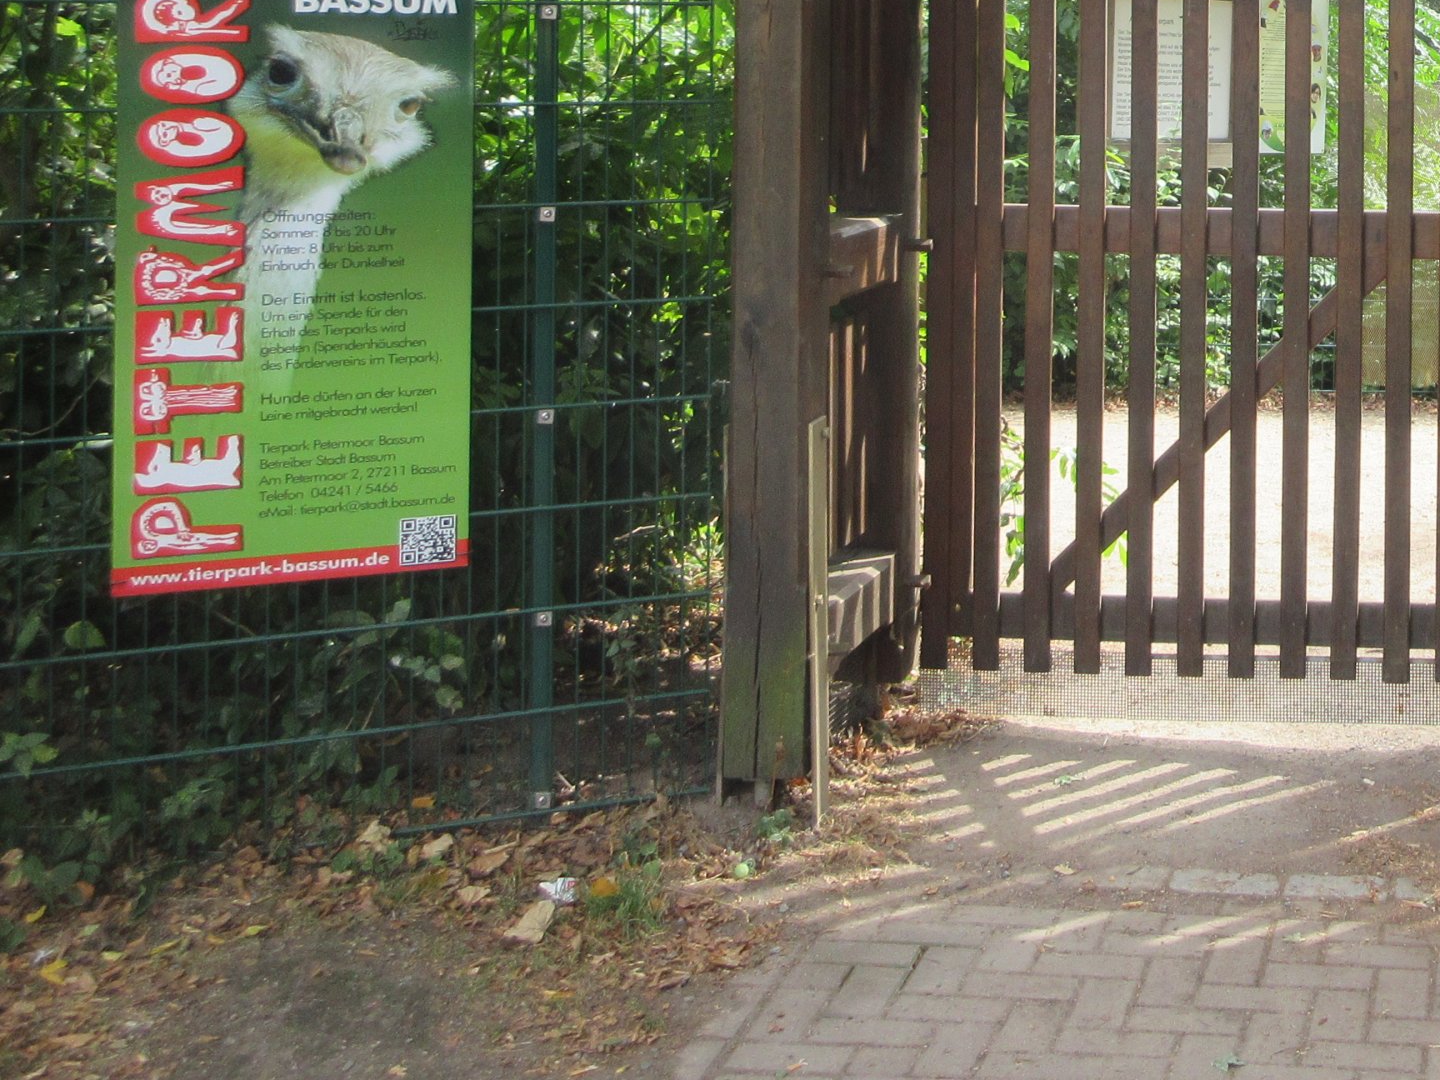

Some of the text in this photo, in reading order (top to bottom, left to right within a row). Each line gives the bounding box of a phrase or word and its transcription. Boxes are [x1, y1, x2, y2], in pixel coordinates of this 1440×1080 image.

[262, 209, 376, 224] Öffnungszeiten:
[261, 224, 398, 240] Sommer: 8 bis 20 Uhr
[261, 242, 393, 255] Winter: 8 Uhr bis zum
[261, 257, 405, 272] Einbruch der Dunkelheit
[261, 288, 427, 306] Der Eintritt ist kostenlos.
[261, 305, 408, 323] Um eine Spende für den
[261, 322, 406, 339] Erhalt des Tierparks wird
[259, 337, 427, 357] gebeten (Spendenhäuschen
[260, 350, 443, 371] des Fördervereins im Tierpark).
[260, 386, 437, 405] Hunde dürfen an der kurzen
[260, 402, 418, 422] Leine mitgebracht werden!
[260, 434, 425, 455] Tierpark Petermoor Bassum
[260, 452, 396, 470] Betreiber Stadt Bassum
[259, 463, 457, 486] Am Petermoor 2, 27211 Bassum
[259, 490, 304, 502] Telefon
[311, 486, 350, 498] 04241
[365, 483, 399, 495] 5466
[259, 493, 456, 518] eMail: tierpark@stadt.bassum.de
[130, 551, 390, 587] www.tierpark-bassum.de
